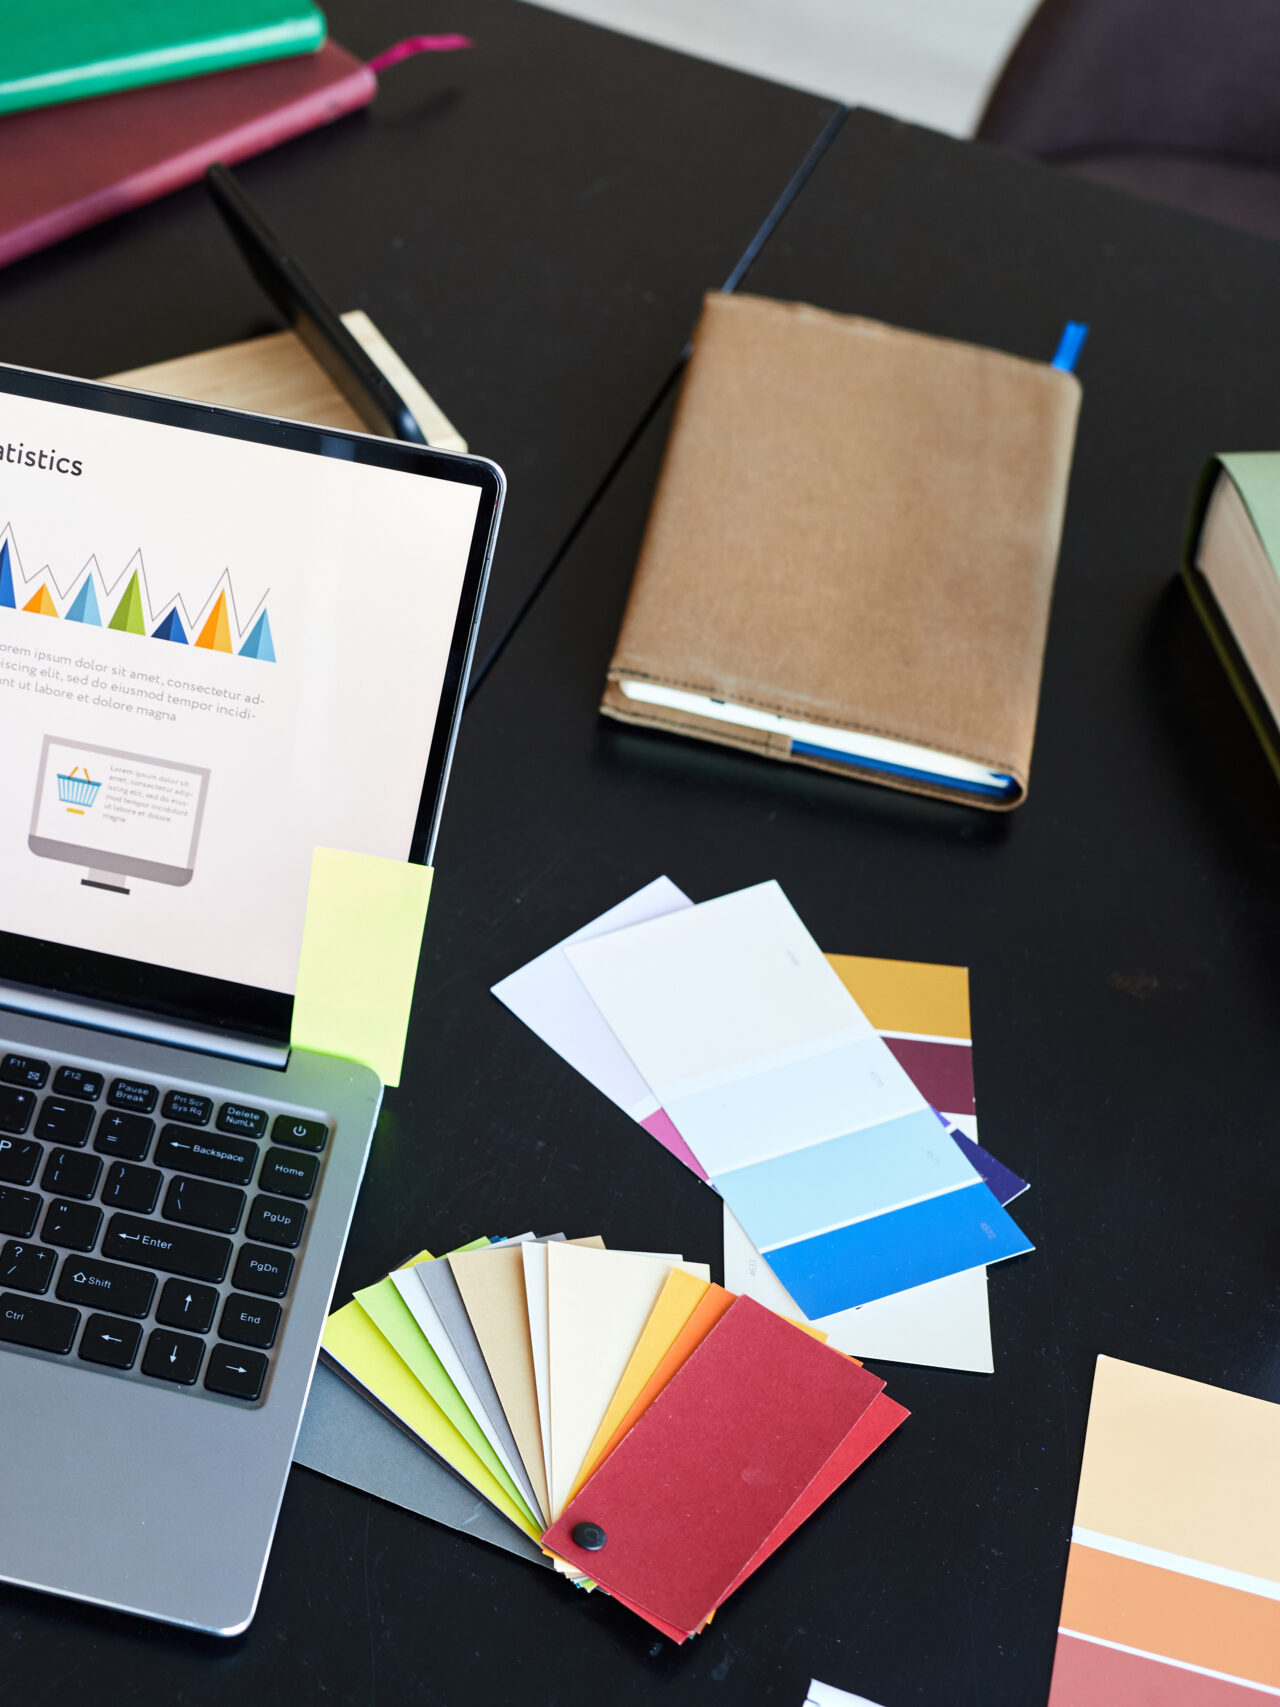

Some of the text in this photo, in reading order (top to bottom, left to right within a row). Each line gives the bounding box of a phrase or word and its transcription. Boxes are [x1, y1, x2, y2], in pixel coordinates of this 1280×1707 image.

[34, 648, 72, 666] ipsum
[74, 657, 108, 673] dolor
[111, 666, 127, 677] sit
[166, 678, 242, 701] consectetur
[67, 673, 88, 686] sed
[91, 677, 107, 690] do
[110, 683, 164, 701] eiusmod
[167, 694, 214, 710] tempor
[18, 681, 31, 691] ut
[34, 682, 74, 700] labore
[77, 692, 89, 703] et
[92, 695, 134, 712] dolore
[136, 704, 177, 722] magna
[9, 1058, 26, 1068] F11
[63, 1070, 82, 1080] F12
[119, 1082, 149, 1095] Pause
[116, 1090, 144, 1103] Break
[227, 1106, 260, 1120] Delete
[112, 1117, 122, 1126] +
[226, 1116, 255, 1128] NumLk
[192, 1144, 244, 1162] Backspace
[275, 1164, 305, 1177] Home
[263, 1211, 292, 1225] PgUp
[141, 1235, 173, 1250] Enter
[14, 1246, 24, 1257] ?
[250, 1260, 278, 1273] PgDn
[88, 1276, 112, 1289] Shift
[5, 1310, 24, 1321] Ctrl
[240, 1312, 261, 1324] End
